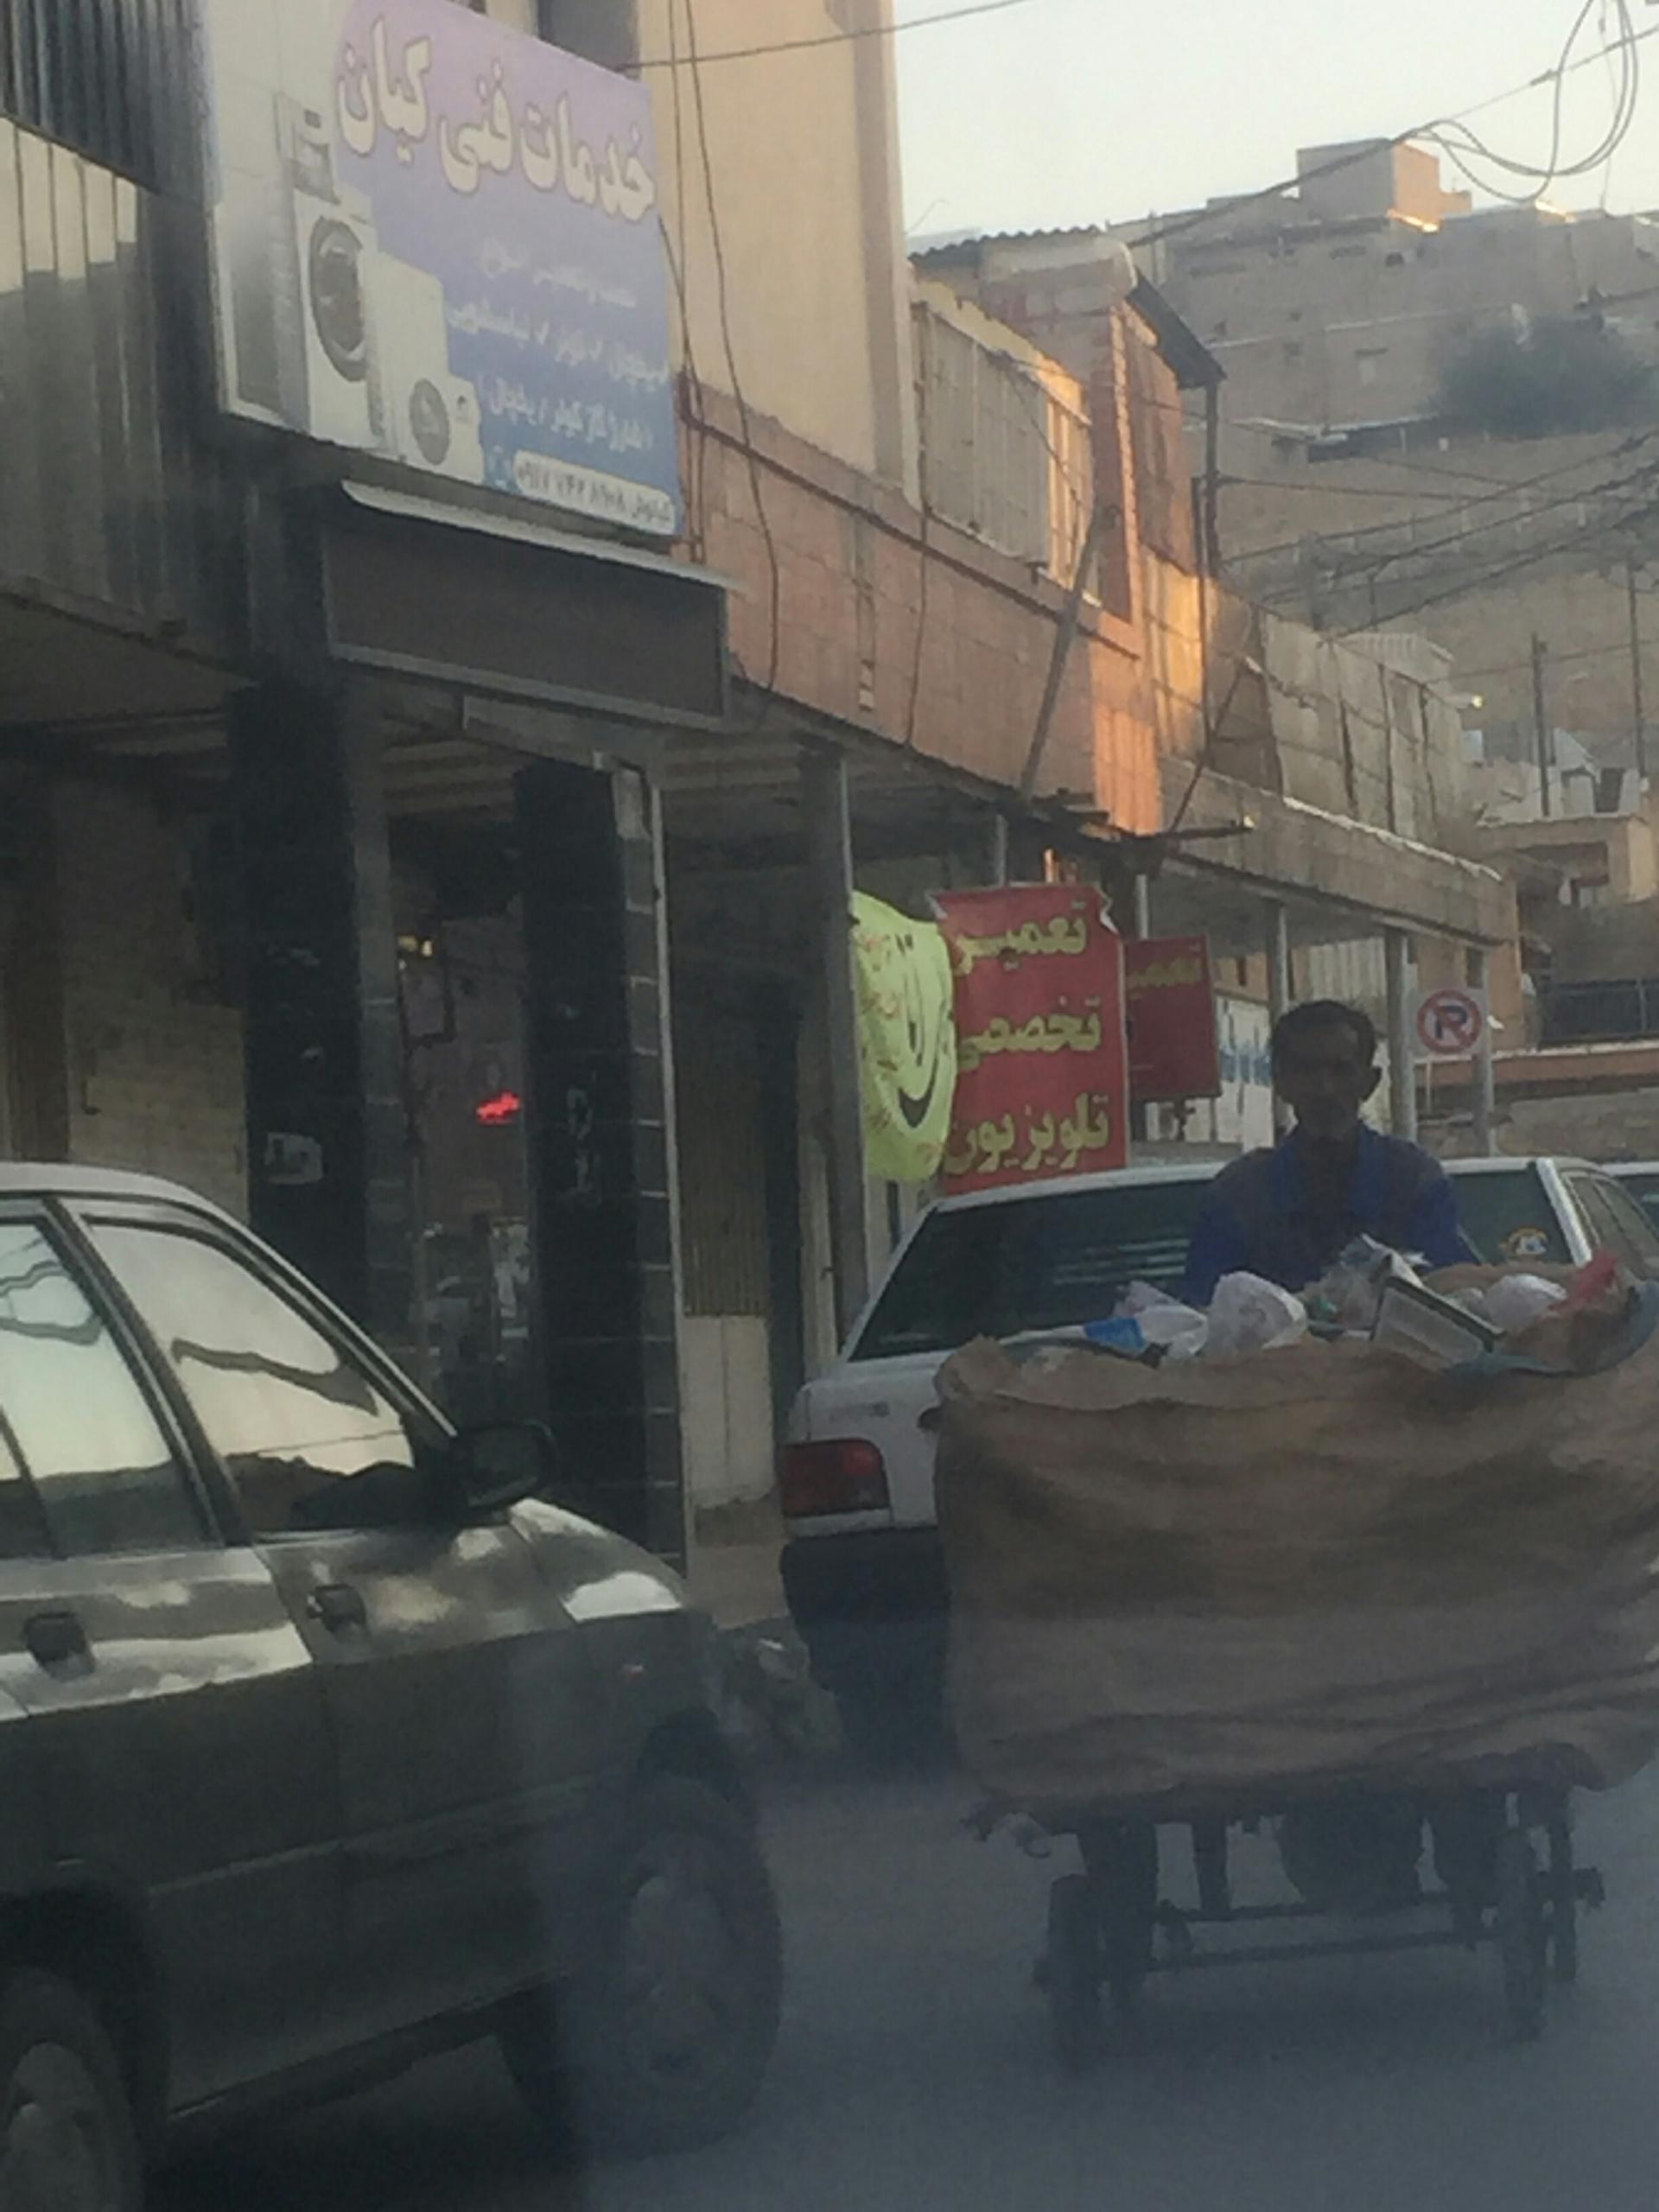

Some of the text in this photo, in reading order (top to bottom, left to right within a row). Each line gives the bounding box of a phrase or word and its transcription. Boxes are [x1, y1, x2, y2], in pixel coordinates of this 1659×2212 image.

[337, 15, 655, 221] خدمات فنی کیان
[954, 899, 1087, 977] تعمیر
[957, 995, 1102, 1072] تخصصی
[945, 1091, 1109, 1175] تلویزیون
